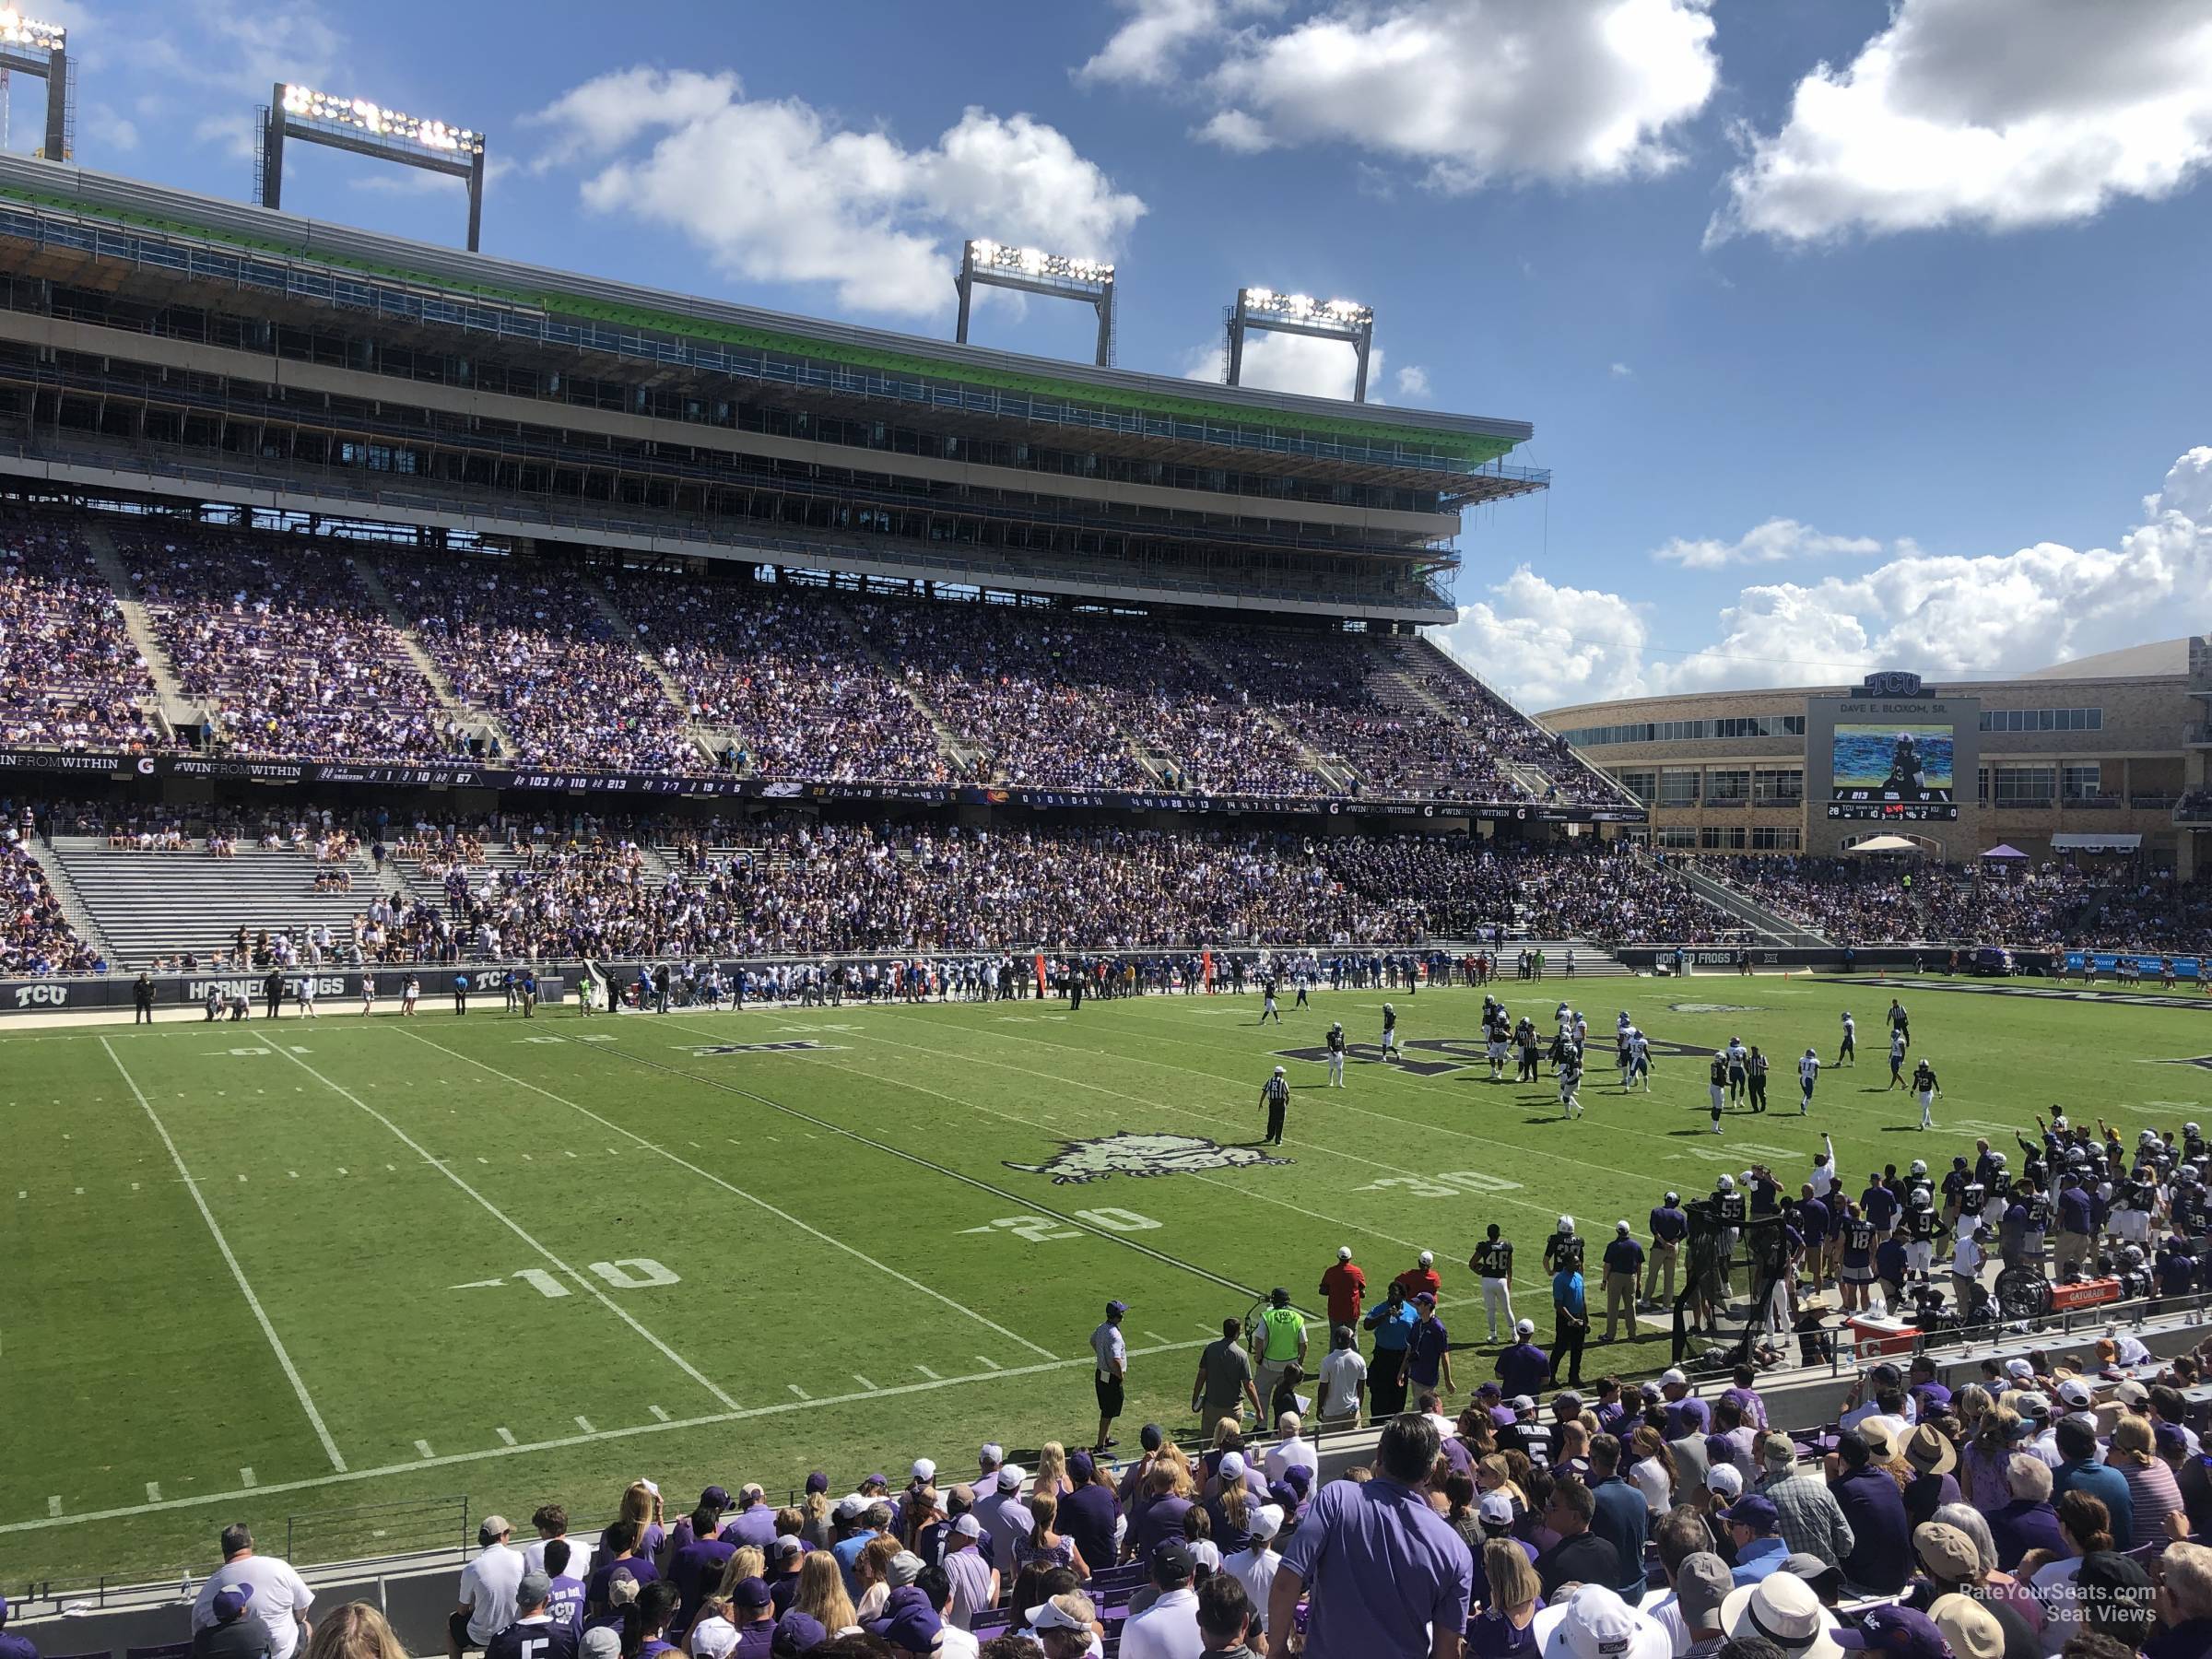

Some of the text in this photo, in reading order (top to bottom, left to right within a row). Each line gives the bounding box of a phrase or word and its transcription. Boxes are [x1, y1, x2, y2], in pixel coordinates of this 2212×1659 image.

[1867, 672, 1922, 696] TCU
[1841, 704, 1866, 712] DAVE
[417, 771, 431, 782] 10
[530, 776, 549, 787] 103
[607, 780, 627, 790] 213
[1829, 806, 1840, 816] 28
[1655, 953, 1731, 964] HORED FROGS
[15, 985, 67, 1007] TCU
[1373, 1171, 1525, 1198] 30
[1722, 1201, 1741, 1218] 55
[990, 1206, 1164, 1242] 20
[1919, 1215, 1930, 1232] 9
[1852, 1230, 1870, 1250] 18
[1484, 1251, 1508, 1270] 46
[511, 1257, 683, 1299] 10
[2068, 1289, 2105, 1301] GATORADE
[1514, 1424, 1552, 1438] TOMLINSON
[1527, 1441, 1549, 1469] 5
